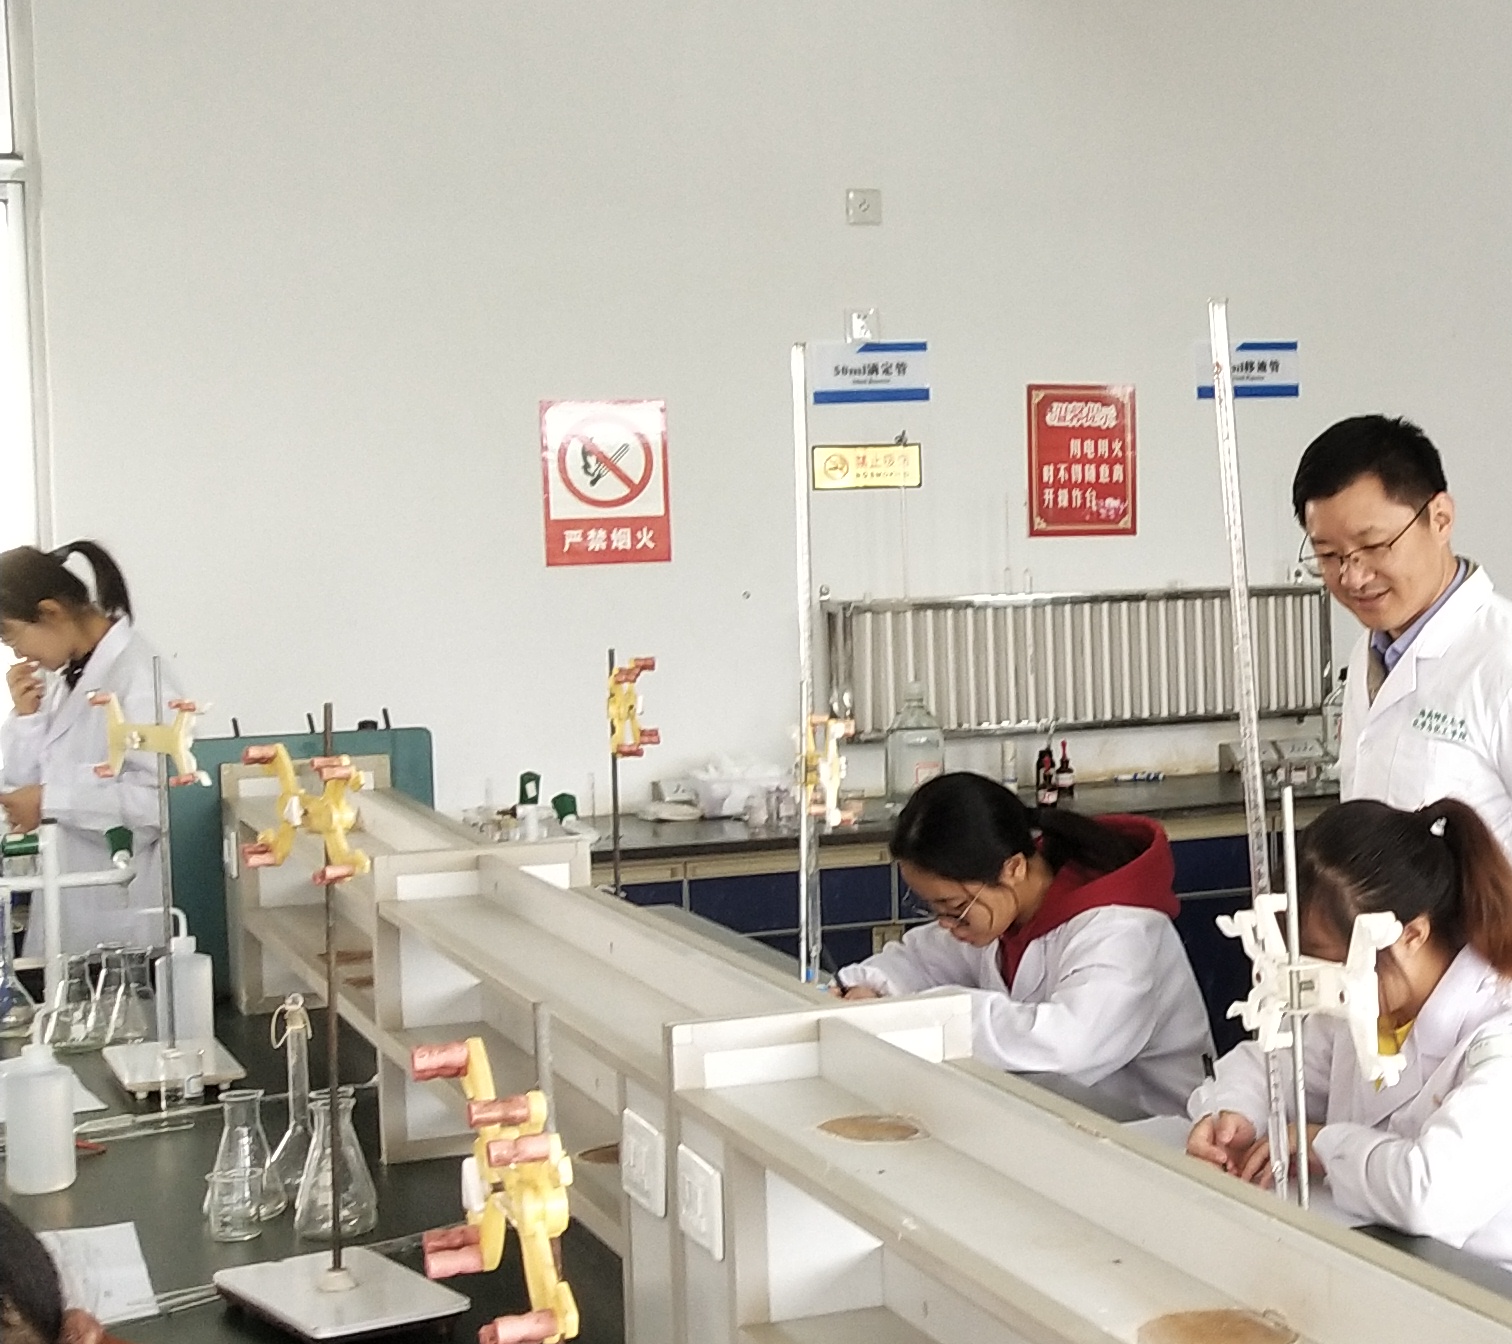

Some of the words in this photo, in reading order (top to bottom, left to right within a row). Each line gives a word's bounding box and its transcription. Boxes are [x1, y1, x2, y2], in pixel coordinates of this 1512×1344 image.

[1070, 438, 1123, 459] 用电用火
[1042, 463, 1124, 484] 时不得随意离
[1043, 487, 1097, 511] 开操作台
[562, 526, 656, 553] 严禁烟火
